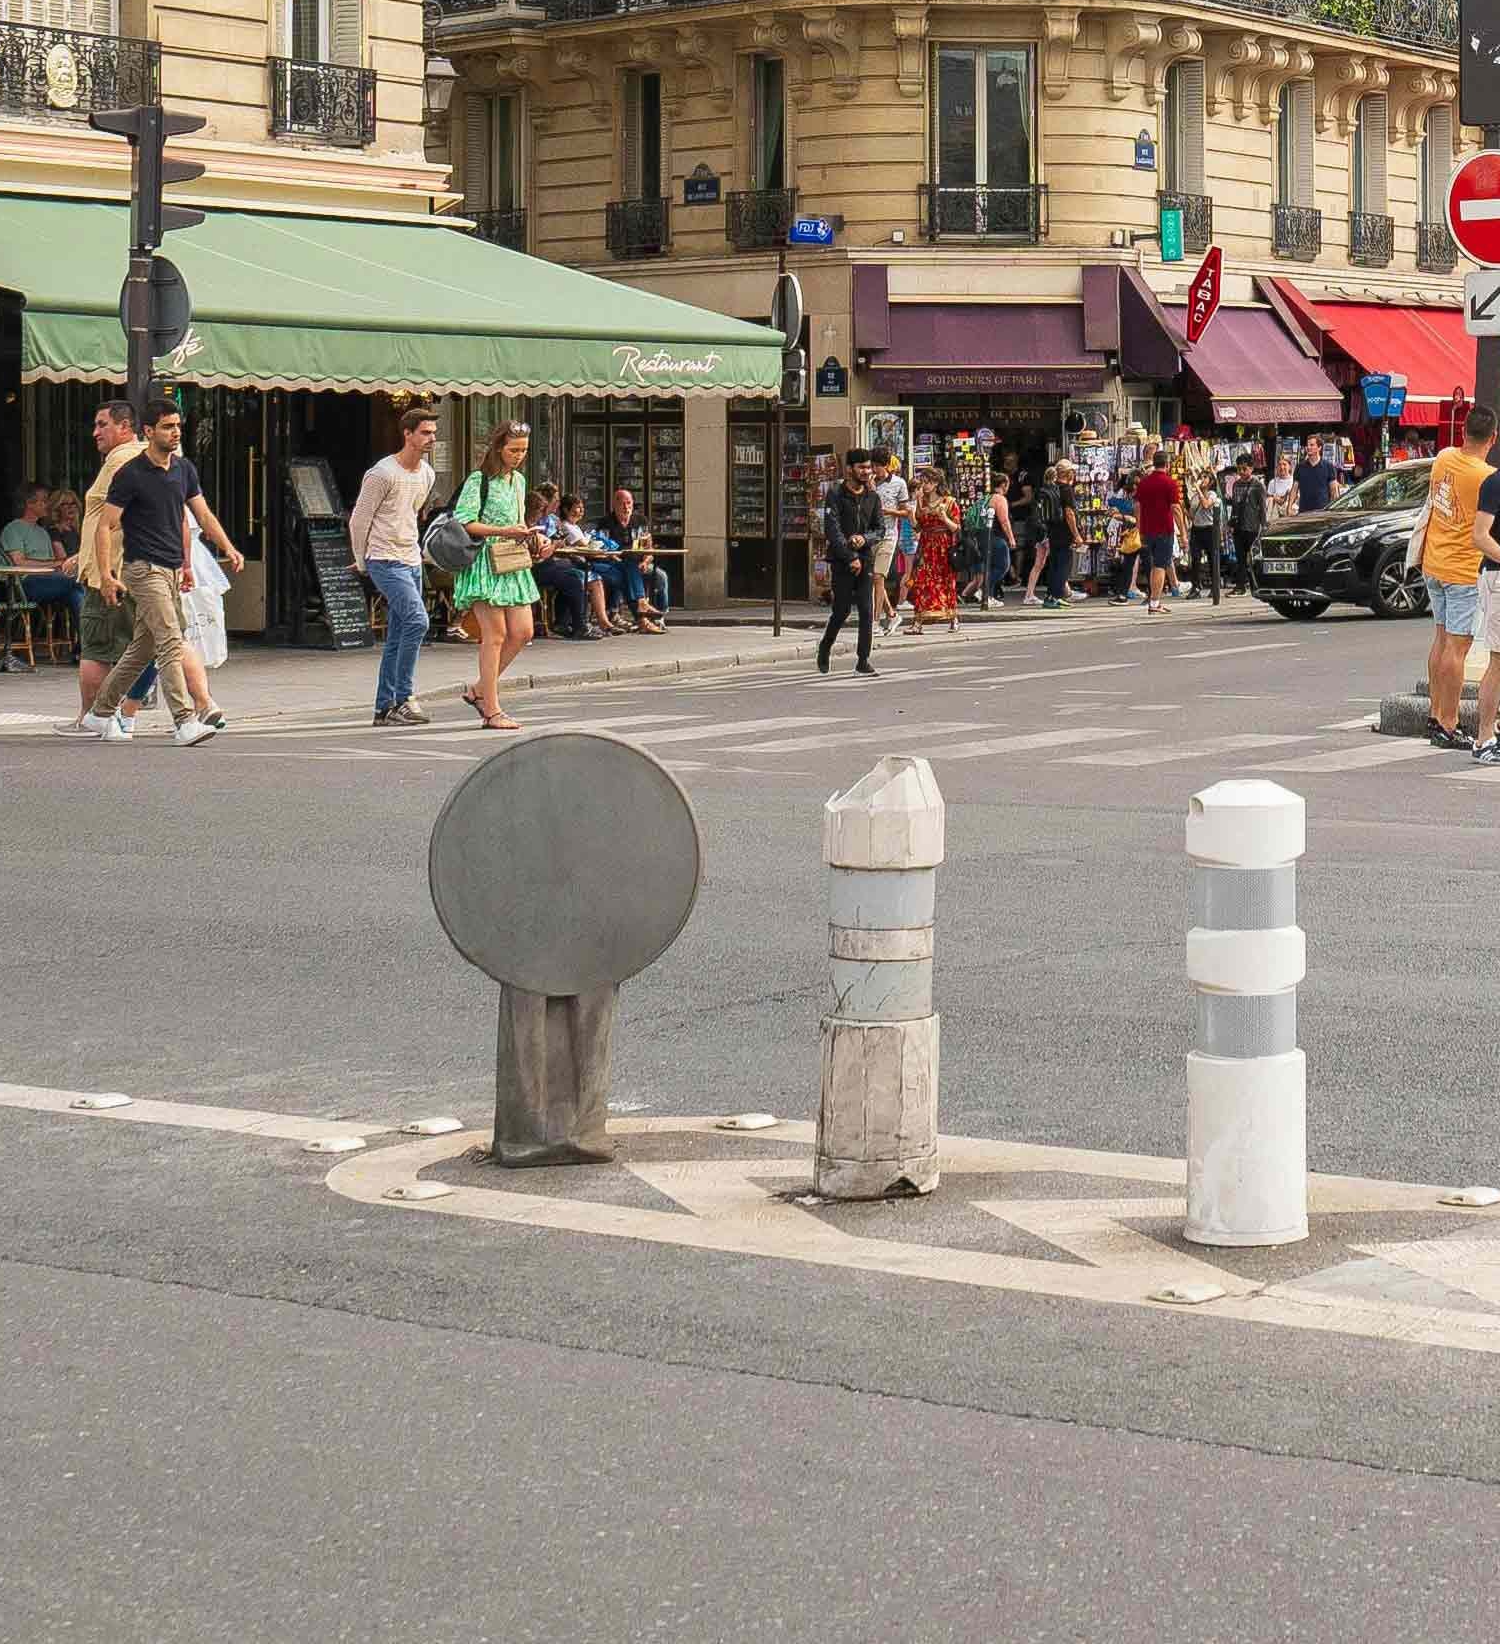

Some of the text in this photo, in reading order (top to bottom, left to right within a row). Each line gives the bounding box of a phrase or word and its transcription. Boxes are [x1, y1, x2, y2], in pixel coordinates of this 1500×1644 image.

[1193, 267, 1215, 323] TABAC
[612, 345, 723, 382] Restaurant
[926, 374, 991, 386] SOUVENIRS
[1012, 374, 1044, 386] PARIS
